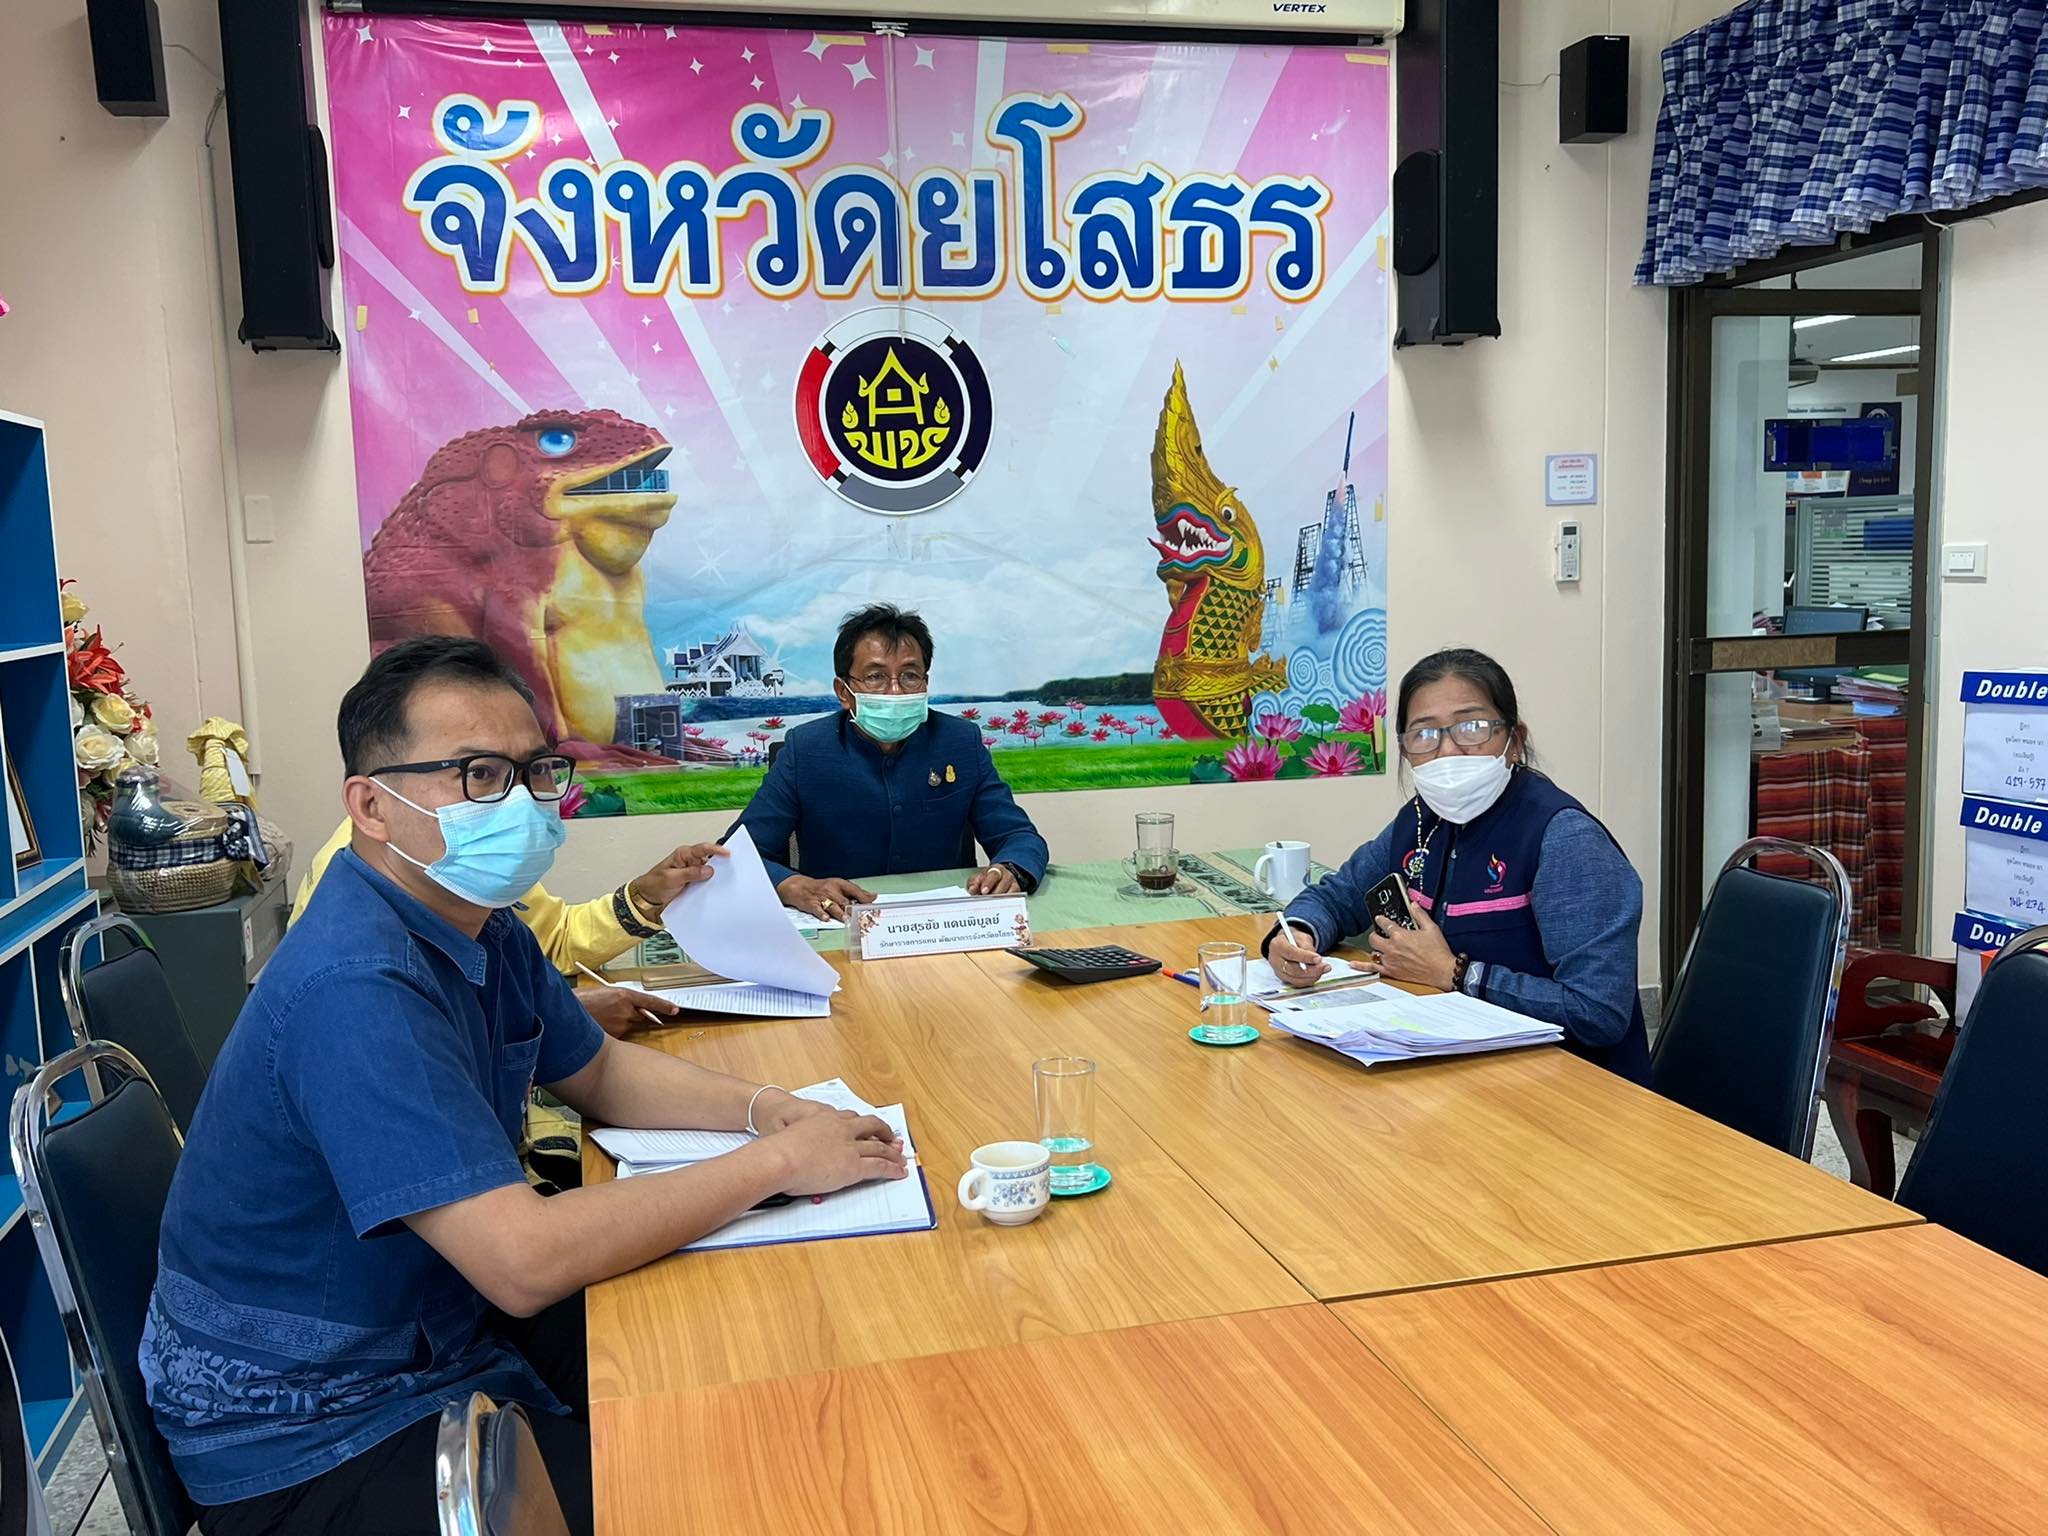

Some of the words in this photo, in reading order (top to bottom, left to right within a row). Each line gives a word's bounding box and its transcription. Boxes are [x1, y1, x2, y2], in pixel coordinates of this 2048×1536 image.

[1273, 4, 1326, 13] VERTEX
[404, 94, 1332, 300] จังหวัดยโสธร
[1976, 679, 2048, 700] Double
[1974, 806, 2043, 834] Double
[888, 918, 940, 934] นายสุรชัย
